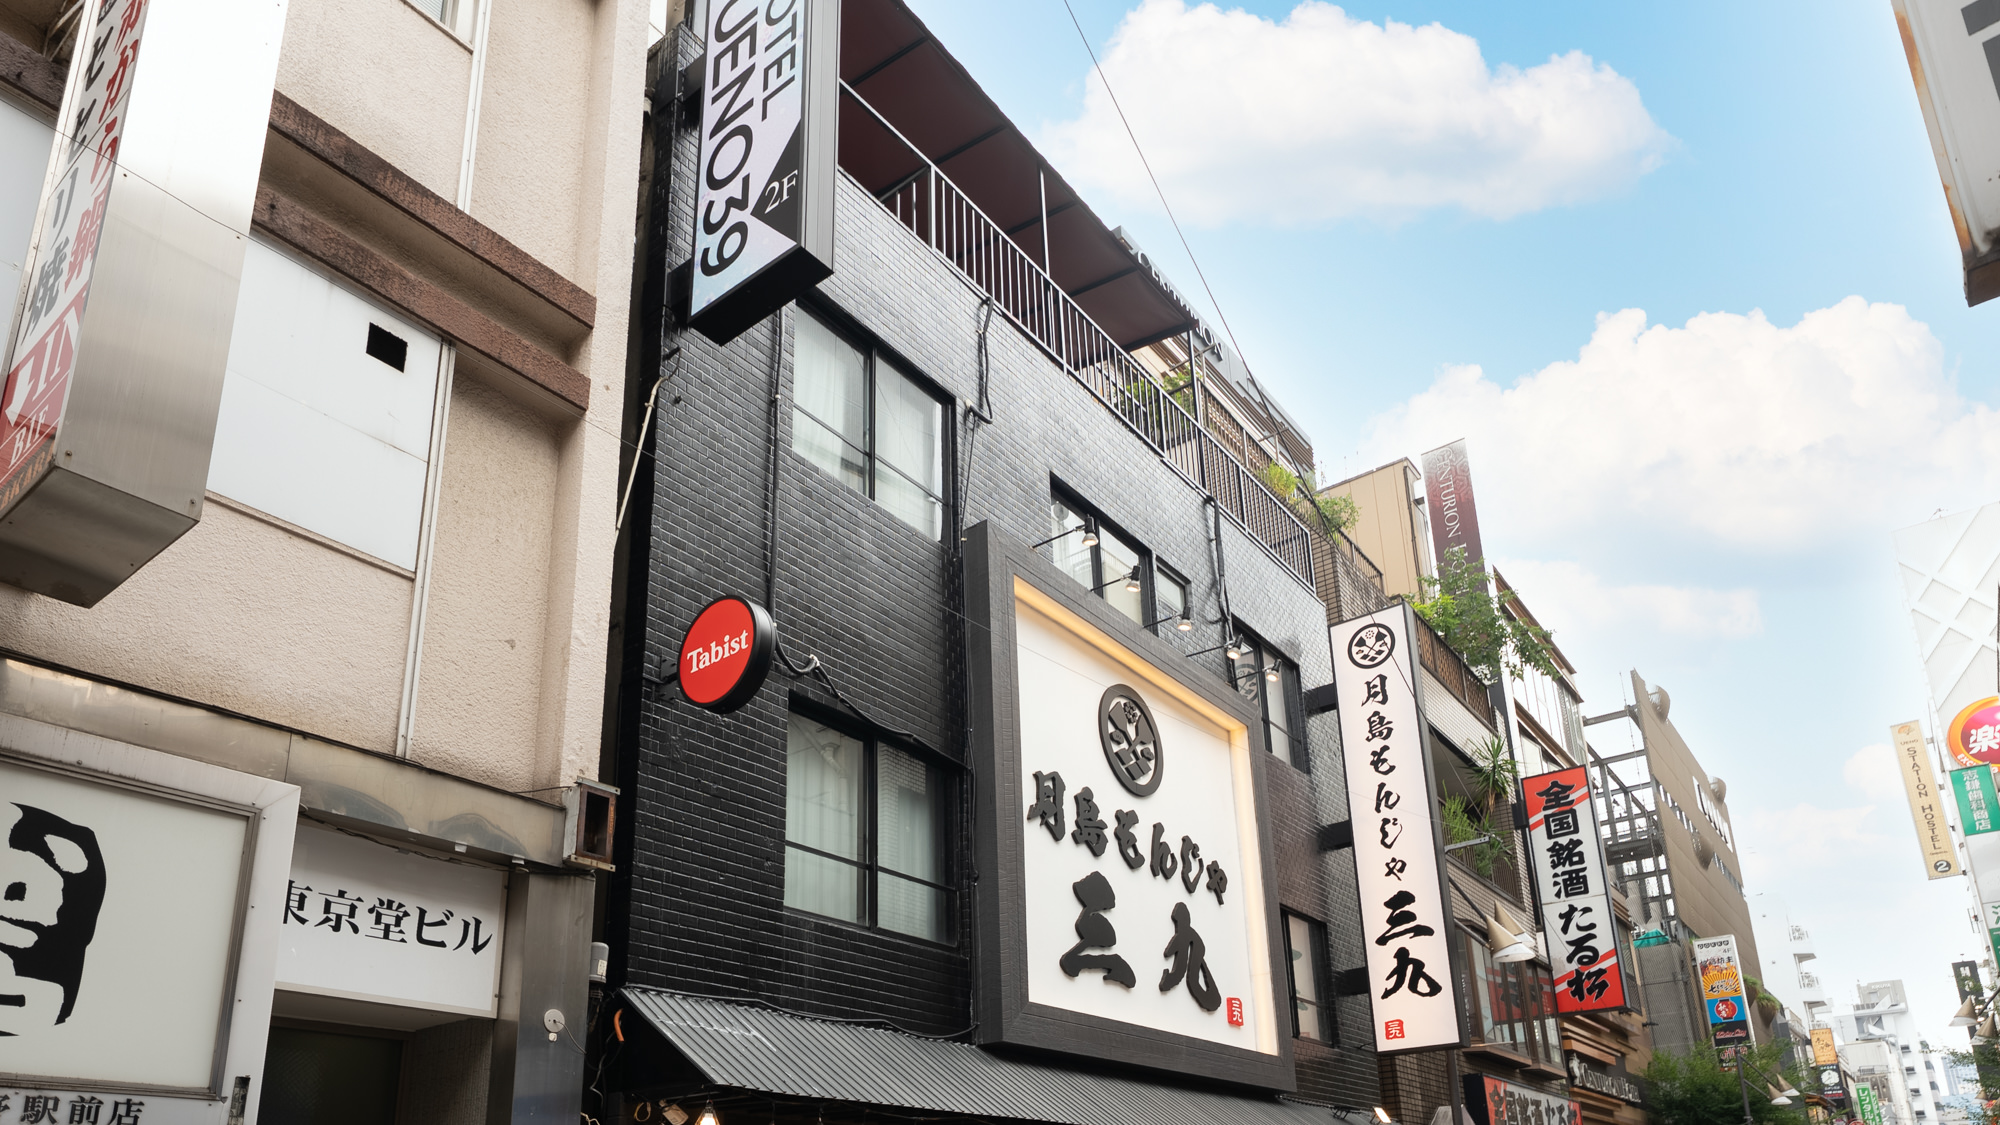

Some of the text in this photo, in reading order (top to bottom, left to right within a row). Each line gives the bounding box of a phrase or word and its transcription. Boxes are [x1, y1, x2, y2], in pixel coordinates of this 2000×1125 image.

[764, 170, 798, 214] 2F
[9, 405, 48, 468] B1F
[1436, 447, 1461, 538] CENTURION
[687, 630, 748, 673] Tabist
[1027, 770, 1228, 905] 月島もんじゃ
[1361, 673, 1442, 1000] 月島もんじゃ 三九
[1907, 747, 1928, 798] STATION
[1921, 804, 1941, 850] HOSTEL
[1536, 780, 1609, 1002] 全国銘酒たる松
[1935, 861, 1951, 872] 2
[283, 879, 493, 955] 東京堂ビル
[1060, 871, 1222, 1012] 三九
